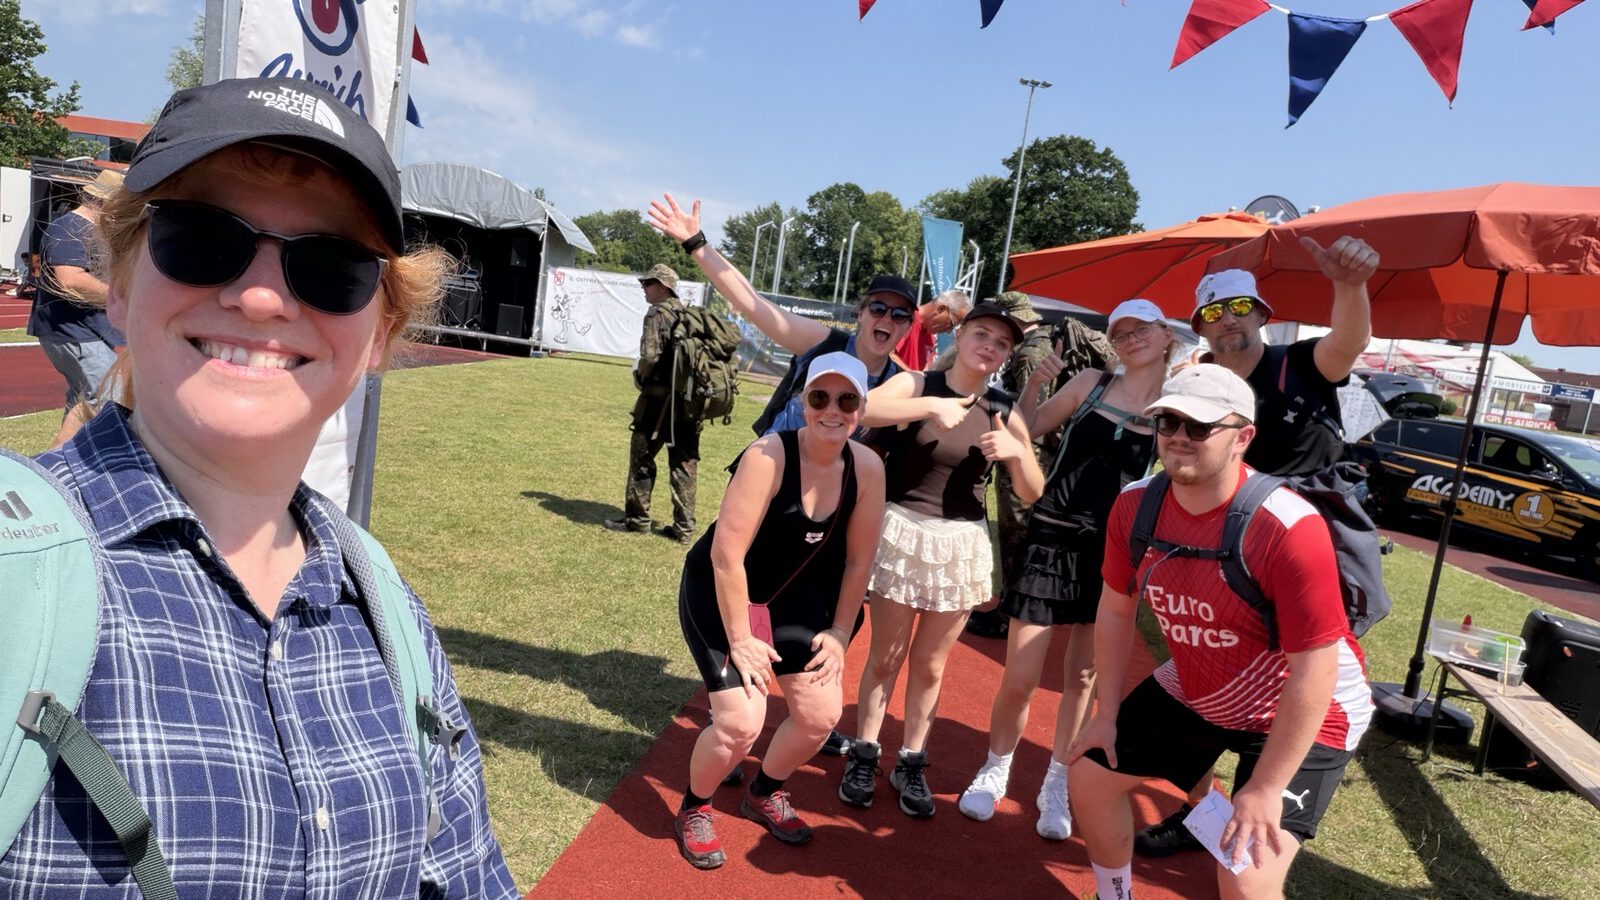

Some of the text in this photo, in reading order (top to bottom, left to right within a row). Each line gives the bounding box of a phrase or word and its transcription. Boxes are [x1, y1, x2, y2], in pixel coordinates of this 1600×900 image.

[247, 90, 316, 113] NORTH
[279, 86, 316, 103] THE
[264, 100, 314, 122] FACE
[1513, 418, 1552, 431] AURICH
[1526, 495, 1541, 512] 1
[1, 523, 60, 540] deuter
[1146, 584, 1215, 622] Euro
[1155, 612, 1240, 649] Parcs
